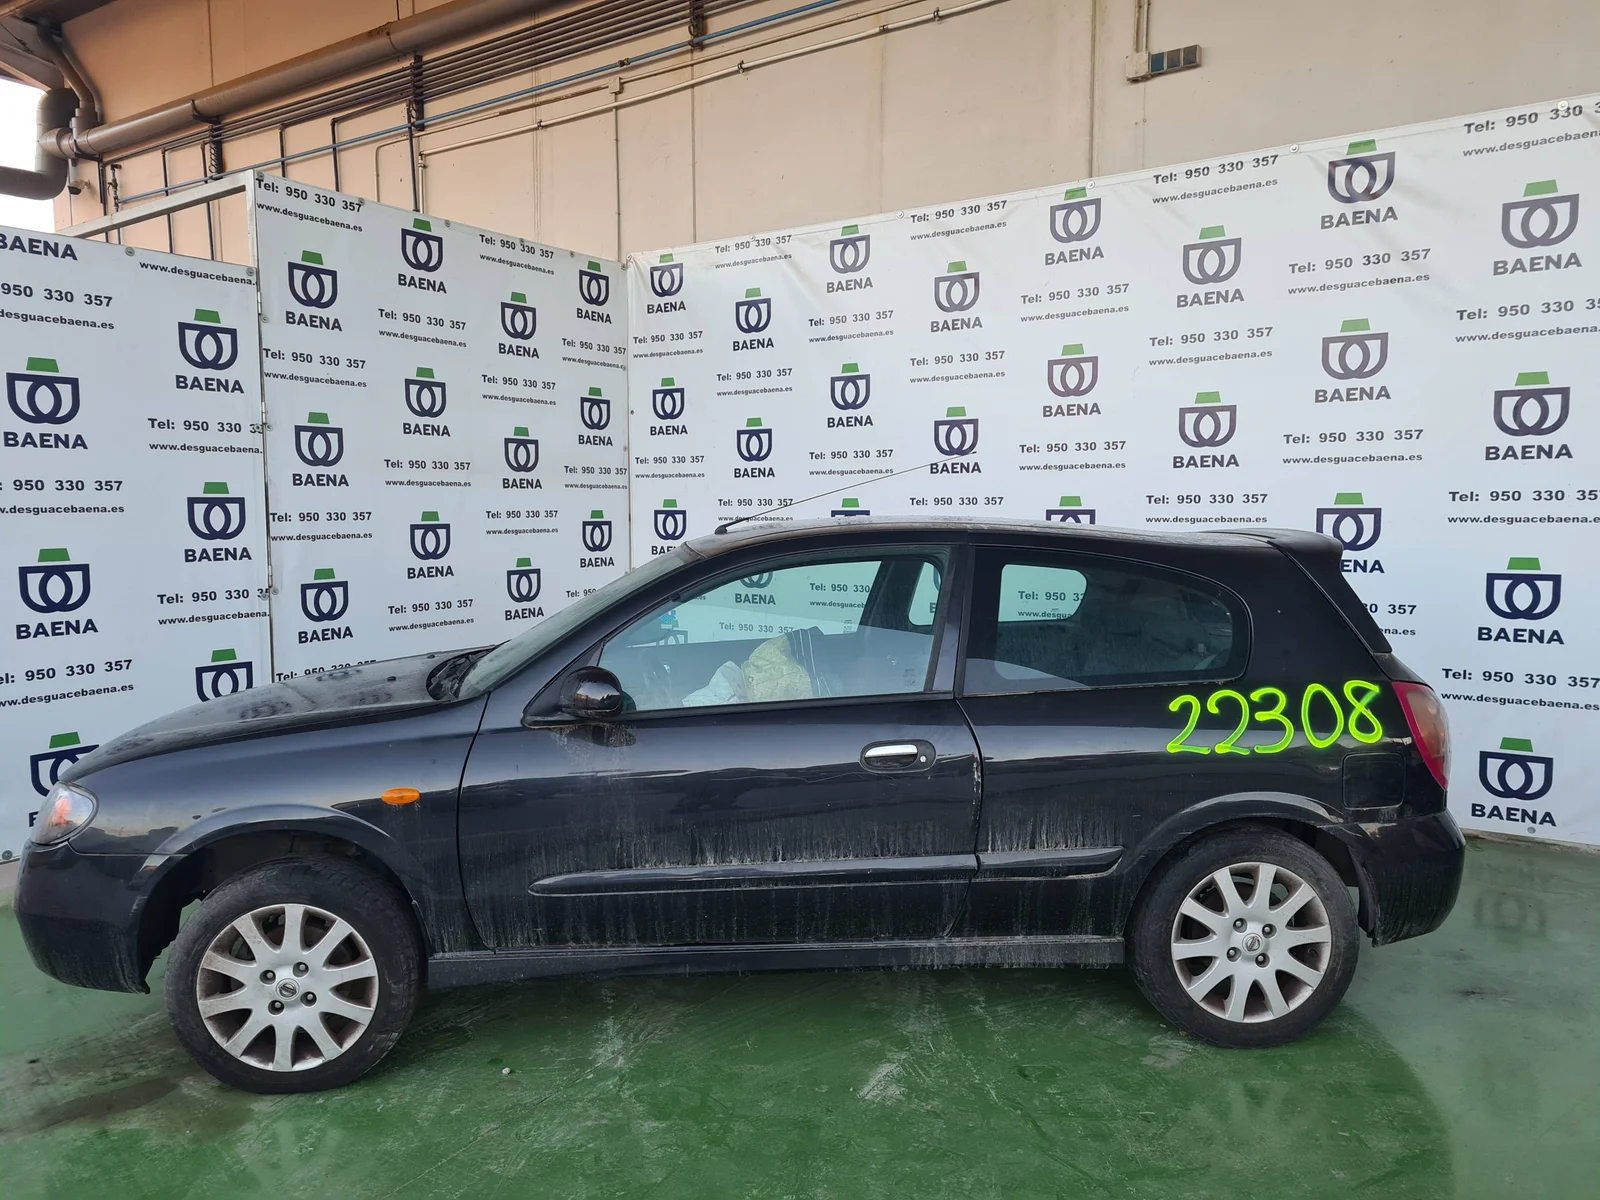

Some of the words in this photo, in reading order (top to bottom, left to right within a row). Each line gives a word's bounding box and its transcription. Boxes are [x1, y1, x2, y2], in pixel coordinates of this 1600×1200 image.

[1153, 172, 1177, 184] Tel:
[1185, 166, 1210, 179] 950
[1218, 161, 1244, 174] 330
[1252, 154, 1279, 168] 357
[1152, 179, 1278, 204] www.desguacebaena.es
[256, 202, 363, 232] www.desguacebaena.es
[910, 213, 929, 223] Tel:
[935, 209, 955, 220] 950
[961, 204, 980, 216] 330
[987, 200, 1007, 211] 357
[1321, 206, 1398, 230] BAENA
[910, 222, 1007, 240] www.desguacebaena.es
[479, 234, 496, 246] Tel:
[500, 239, 516, 250] 950
[520, 243, 535, 255] 330
[540, 248, 554, 259] 357
[1045, 246, 1104, 266] BAENA
[1289, 262, 1316, 274] Tel:
[1325, 257, 1353, 270] 950
[1362, 253, 1391, 266] 330
[1401, 248, 1431, 262] 357
[479, 254, 554, 275] www.desguacebaena.es
[1493, 252, 1582, 276] BAENA
[398, 273, 447, 294] BAENA
[827, 277, 873, 293] BAENA
[1288, 274, 1430, 294] www.desguacebaena.es
[1021, 294, 1042, 304] Tel:
[1049, 290, 1070, 301] 950
[1077, 287, 1099, 298] 330
[1107, 283, 1129, 295] 357
[1177, 288, 1244, 308] BAENA
[647, 301, 686, 314] BAENA
[1020, 306, 1129, 322] www.desguacebaena.es
[285, 311, 342, 332] BAENA
[378, 308, 397, 320] Tel:
[402, 312, 421, 324] 950
[427, 316, 444, 327] 330
[449, 320, 466, 330] 357
[577, 308, 612, 324] BAENA
[808, 318, 825, 327] Tel:
[829, 315, 847, 325] 950
[852, 313, 870, 322] 330
[876, 310, 894, 320] 357
[931, 317, 983, 333] BAENA
[378, 330, 467, 347] www.desguacebaena.es
[633, 336, 648, 344] Tel:
[650, 334, 665, 343] 950
[670, 332, 684, 341] 330
[688, 330, 703, 339] 357
[733, 337, 774, 351] BAENA
[1149, 336, 1173, 347] Tel:
[1181, 333, 1205, 344] 950
[1213, 330, 1238, 341] 330
[1247, 327, 1273, 338] 357
[498, 343, 539, 359] BAENA
[633, 349, 703, 358] www.desguacebaena.es
[910, 357, 928, 366] Tel:
[934, 355, 953, 365] 950
[960, 353, 979, 363] 330
[985, 350, 1005, 361] 357
[1149, 351, 1272, 366] www.desguacebaena.es
[264, 370, 367, 388] www.desguacebaena.es
[481, 374, 498, 384] Tel:
[502, 376, 518, 386] 950
[523, 379, 537, 388] 330
[542, 381, 556, 390] 357
[716, 373, 732, 381] Tel:
[736, 371, 751, 380] 950
[756, 369, 772, 378] 330
[777, 368, 792, 377] 357
[910, 371, 1005, 383] www.desguacebaena.es
[175, 375, 244, 394] BAENA
[717, 387, 793, 396] www.desguacebaena.es
[482, 394, 556, 406] www.desguacebaena.es
[1315, 385, 1391, 403] BAENA
[1043, 402, 1101, 418] BAENA
[827, 415, 873, 428] BAENA
[403, 422, 451, 437] BAENA
[650, 425, 688, 436] BAENA
[1283, 434, 1310, 444] Tel:
[1319, 432, 1346, 443] 950
[1356, 430, 1384, 442] 330
[1394, 429, 1423, 440] 357
[3, 431, 88, 450] BAENA
[578, 434, 613, 446] BAENA
[1019, 444, 1040, 453] Tel:
[1046, 443, 1068, 452] 950
[1075, 442, 1097, 451] 330
[1104, 441, 1126, 450] 357
[653, 456, 667, 464] 950
[671, 456, 686, 464] 330
[690, 455, 705, 463] 357
[809, 452, 826, 460] Tel:
[831, 451, 848, 459] 950
[853, 450, 870, 459] 330
[876, 449, 893, 458] 357
[1282, 454, 1423, 465] www.desguacebaena.es
[1485, 444, 1573, 461] BAENA
[384, 459, 403, 468] Tel:
[408, 460, 426, 469] 950
[432, 461, 449, 470] 330
[454, 461, 471, 470] 357
[929, 460, 982, 474] BAENA
[1019, 462, 1126, 471] www.desguacebaena.es
[1173, 454, 1239, 469] BAENA
[635, 472, 705, 480] www.desguacebaena.es
[734, 467, 775, 478] BAENA
[809, 468, 894, 476] www.desguacebaena.es
[292, 473, 349, 487] BAENA
[385, 479, 471, 488] www.desguacebaena.es
[502, 478, 542, 489] BAENA
[909, 497, 928, 506] Tel:
[934, 497, 953, 506] 950
[959, 497, 978, 506] 330
[984, 497, 1004, 505] 357
[1146, 495, 1169, 504] Tel:
[1177, 494, 1201, 504] 950
[1209, 494, 1234, 504] 330
[1242, 494, 1268, 503] 357
[270, 512, 292, 522] Tel:
[298, 512, 319, 522] 950
[326, 512, 346, 521] 330
[352, 512, 372, 521] 357
[486, 510, 501, 519] Tel:
[506, 510, 521, 519] 950
[525, 510, 540, 518] 330
[544, 510, 558, 518] 357
[1145, 516, 1267, 524] www.desguacebaena.es
[271, 531, 373, 542] www.desguacebaena.es
[486, 528, 558, 536] www.desguacebaena.es
[184, 547, 252, 563] BAENA
[580, 557, 615, 568] BAENA
[407, 565, 454, 579] BAENA
[388, 605, 406, 614] Tel:
[412, 603, 430, 612] 950
[435, 601, 452, 610] 330
[457, 599, 473, 608] 357
[735, 593, 776, 605] BAENA
[505, 607, 544, 621] BAENA
[16, 618, 99, 640] BAENA
[298, 626, 353, 644] BAENA
[1478, 627, 1564, 645] BAENA
[1442, 668, 1472, 680] Tel:
[1482, 671, 1514, 683] 950
[1524, 673, 1556, 686] 330
[1568, 676, 1600, 688] 357
[1441, 693, 1600, 711] www.desguacebaena.es
[1471, 803, 1557, 827] BAENA
